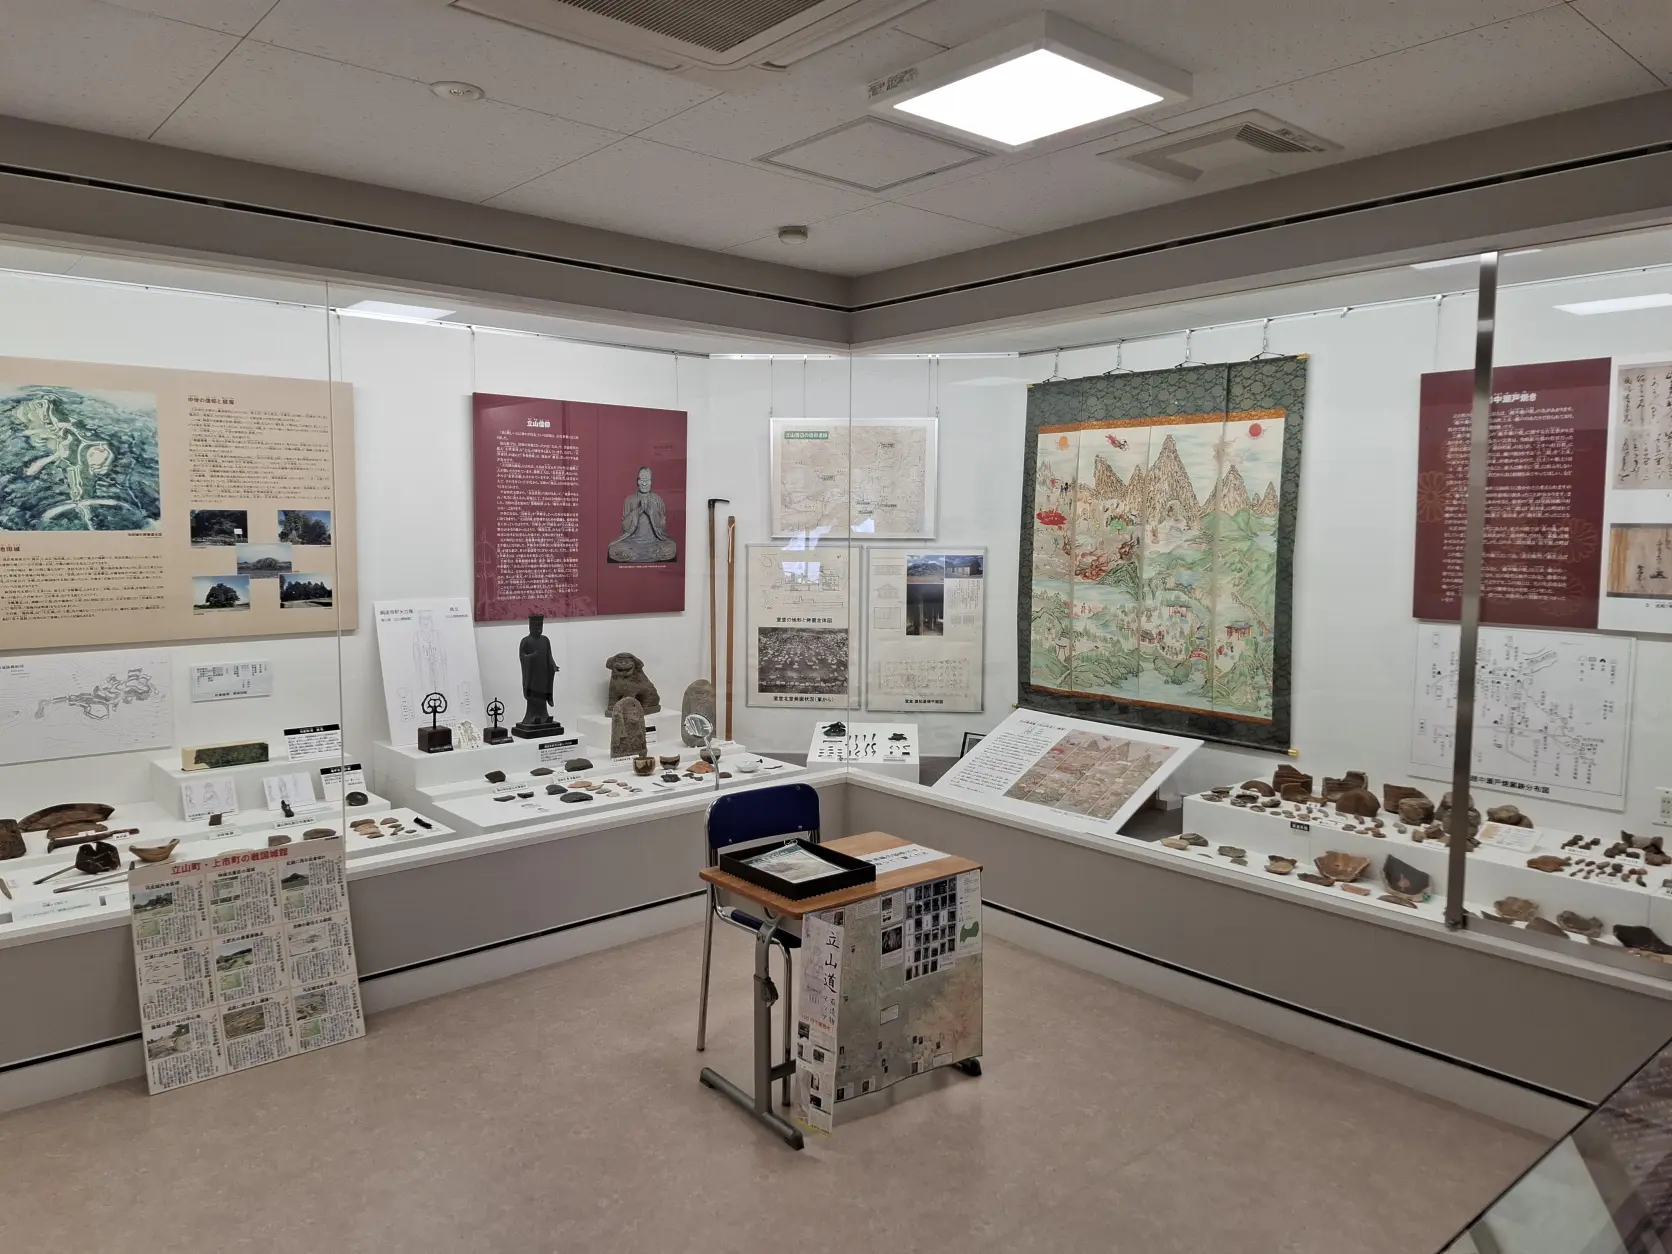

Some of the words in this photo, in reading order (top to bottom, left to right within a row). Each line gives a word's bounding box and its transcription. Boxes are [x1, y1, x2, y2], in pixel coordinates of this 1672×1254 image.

[1490, 393, 1537, 403] 中瀬戸焼き
[171, 847, 289, 876] 立山町・上市町の戦国城館
[824, 932, 840, 993] 立山道
